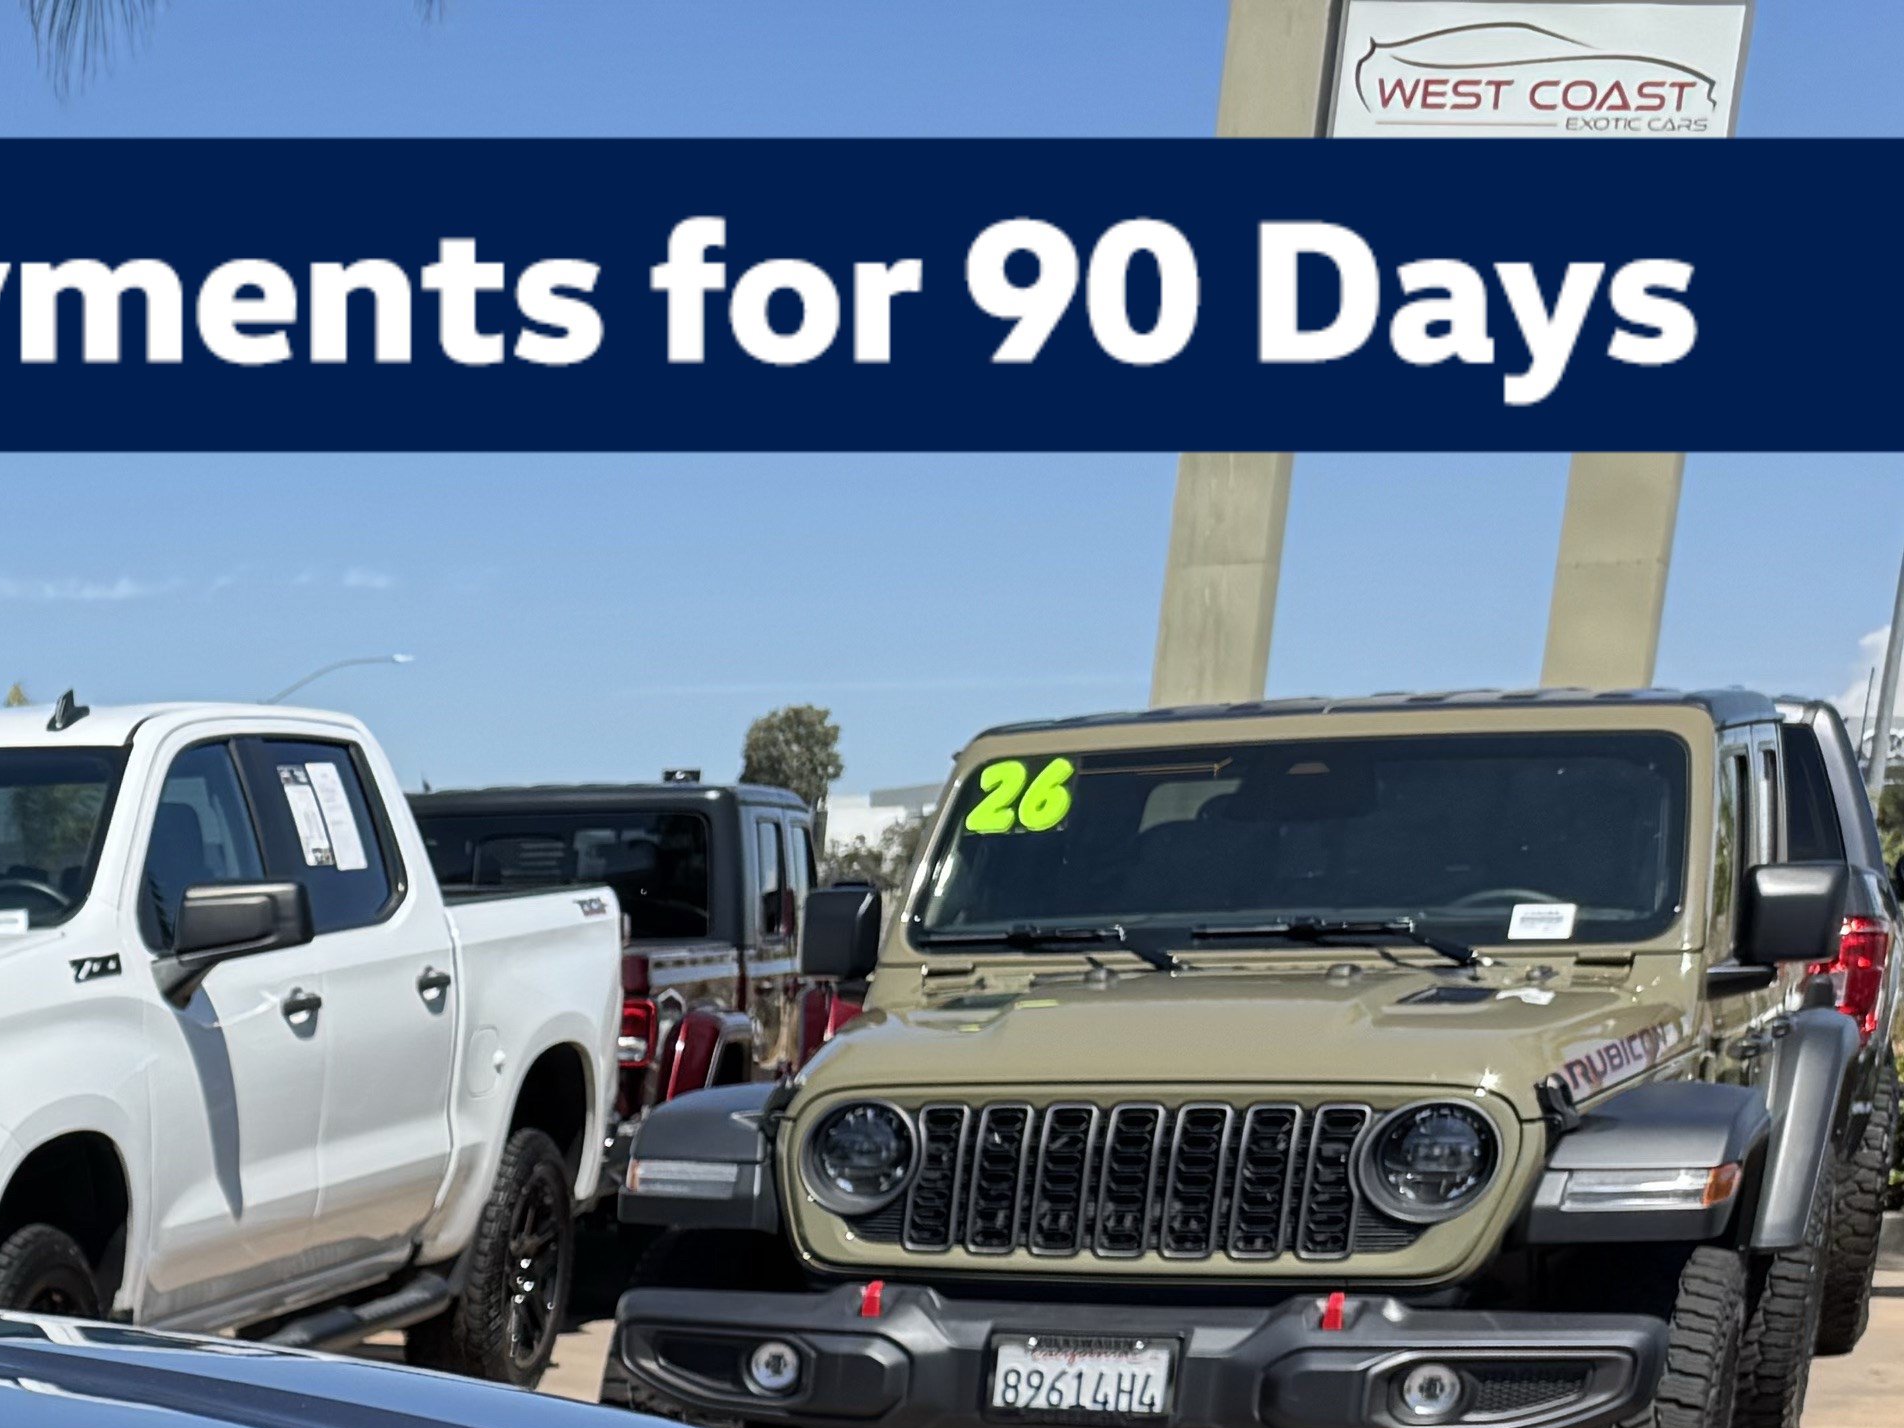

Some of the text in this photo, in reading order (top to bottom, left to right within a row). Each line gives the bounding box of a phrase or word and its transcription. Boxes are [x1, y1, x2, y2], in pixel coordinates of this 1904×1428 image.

[1377, 78, 1698, 112] WEST COAST
[1565, 117, 1708, 132] EXOTIC CARS
[965, 757, 1074, 834] 26
[1564, 1022, 1668, 1090] RUBICON
[1002, 1368, 1156, 1413] 89614H4
